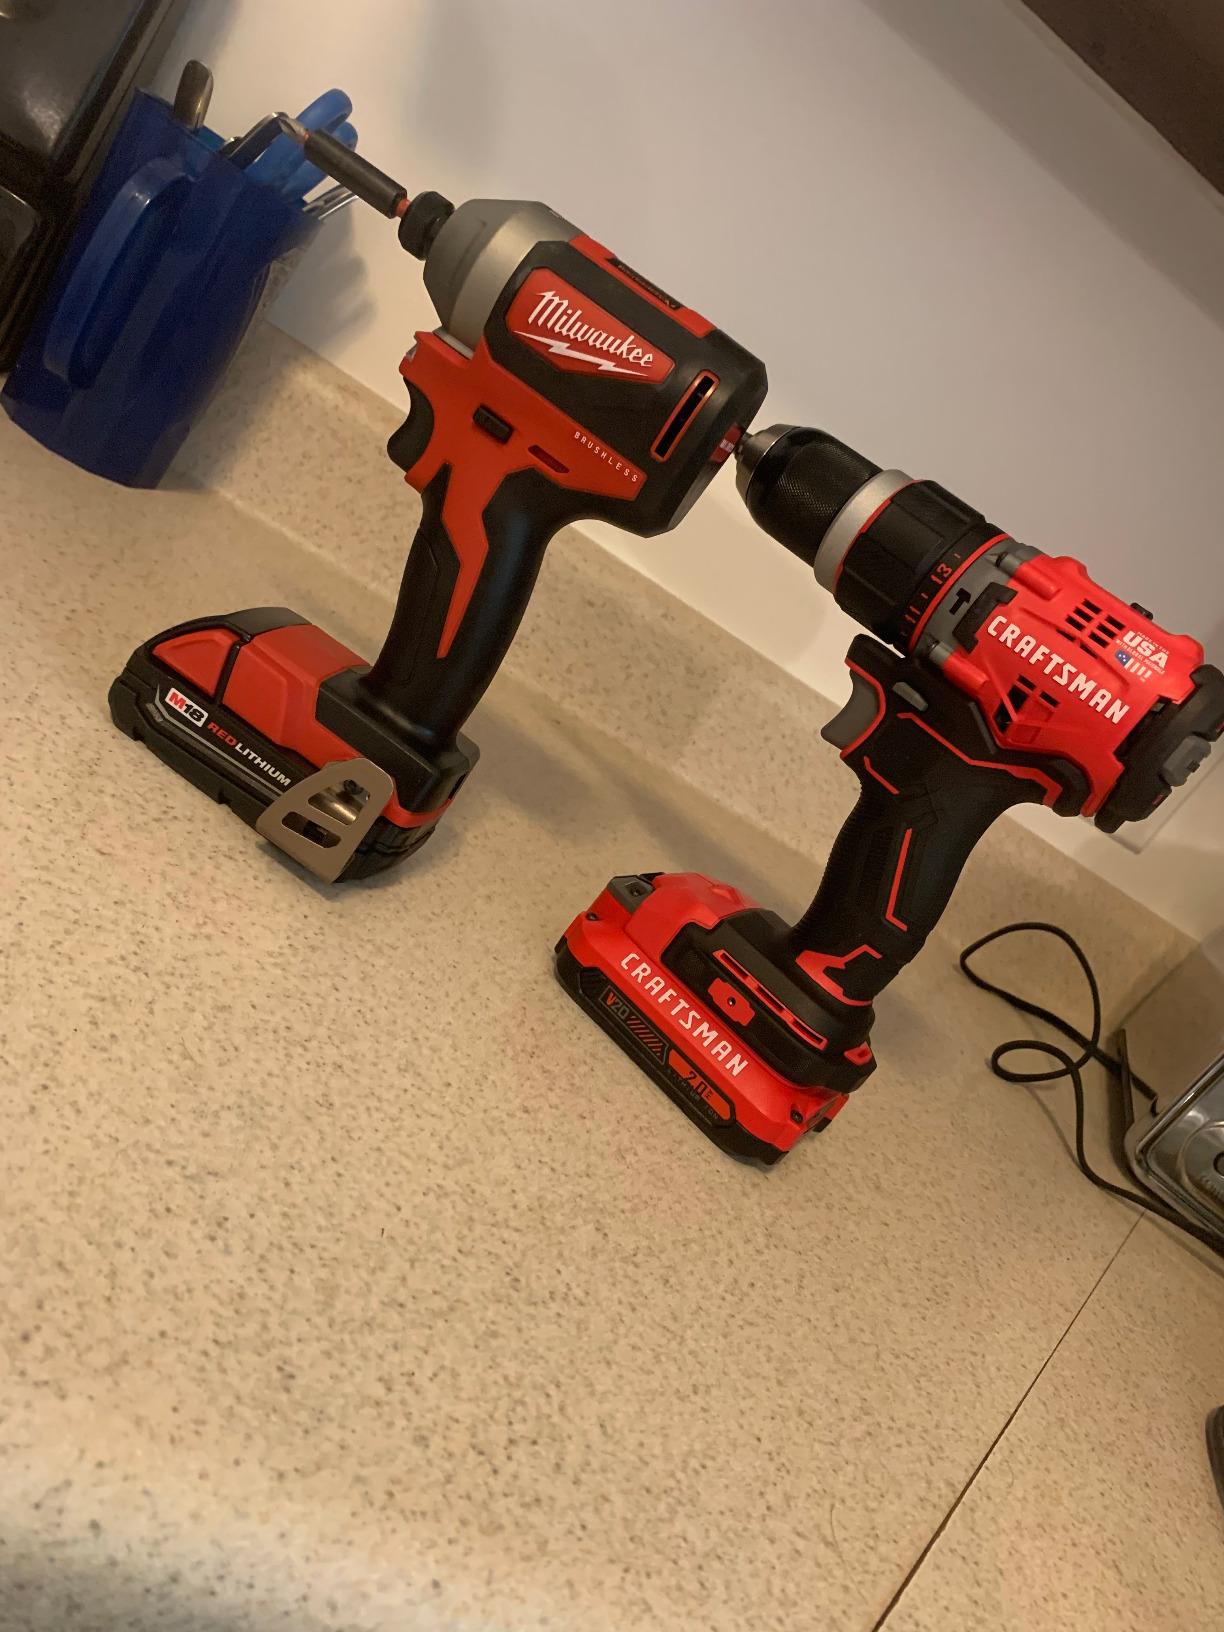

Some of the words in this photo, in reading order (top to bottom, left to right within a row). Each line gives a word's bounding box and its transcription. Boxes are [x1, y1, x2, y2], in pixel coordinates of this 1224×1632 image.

[527, 290, 653, 367] Milwaukee
[573, 431, 638, 482] BRUSHLESS
[930, 562, 953, 585] 13
[986, 615, 1130, 724] CRAFTSMAN
[1122, 630, 1169, 669] USA
[168, 691, 205, 723] M18
[606, 991, 630, 1020] V20
[620, 952, 749, 1077] CRAFTSMAN
